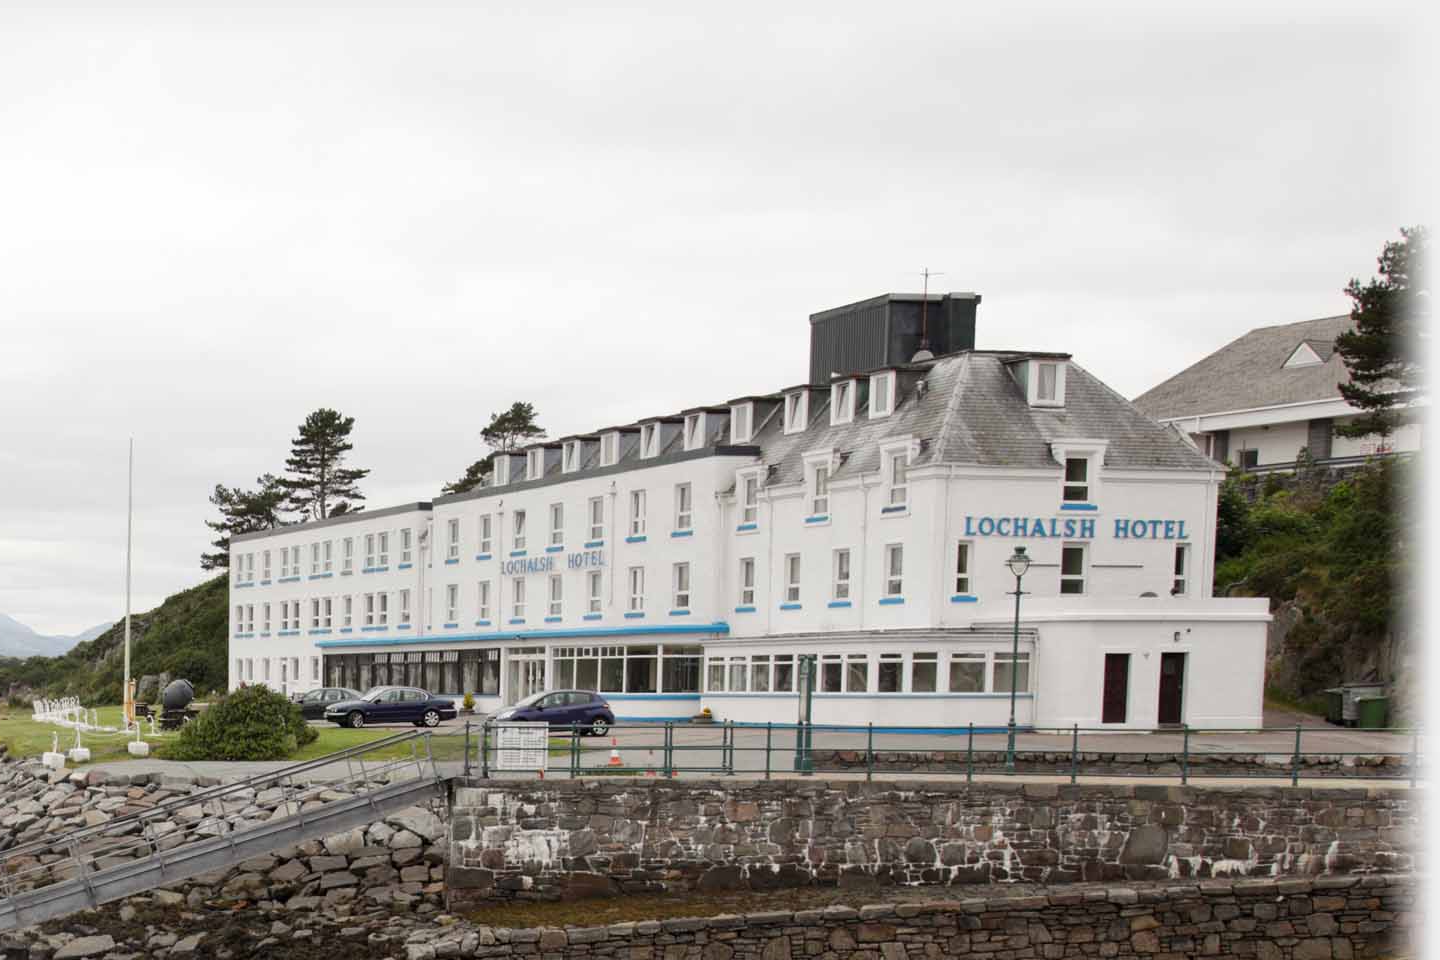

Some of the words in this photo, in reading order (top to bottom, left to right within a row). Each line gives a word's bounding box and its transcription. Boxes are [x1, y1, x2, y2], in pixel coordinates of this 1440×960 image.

[965, 516, 1096, 538] LOCHALSH
[1113, 519, 1189, 540] HOTEL
[501, 556, 553, 575] LOCHALSH
[568, 550, 606, 569] HOTEL
